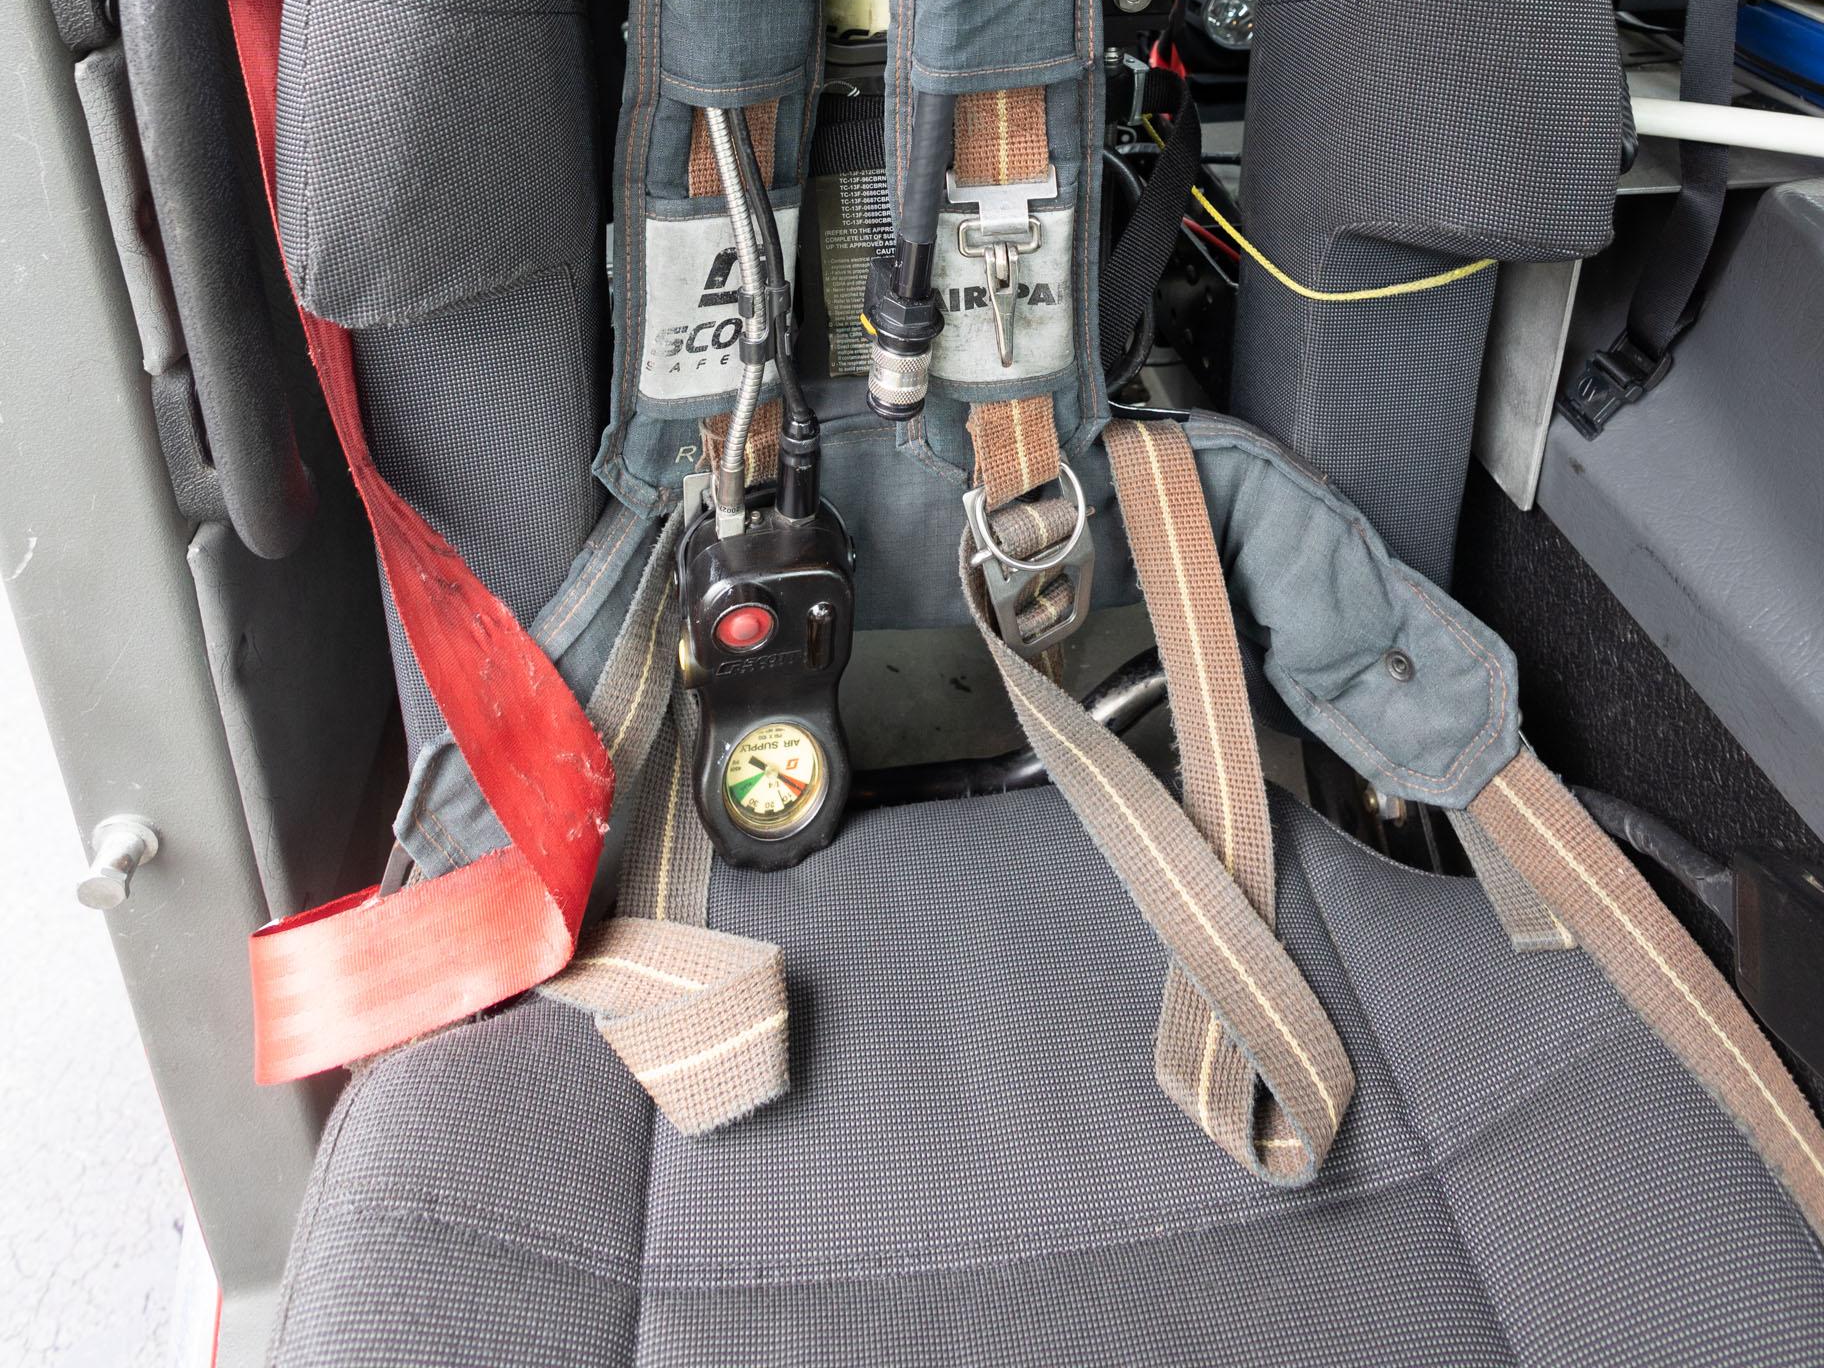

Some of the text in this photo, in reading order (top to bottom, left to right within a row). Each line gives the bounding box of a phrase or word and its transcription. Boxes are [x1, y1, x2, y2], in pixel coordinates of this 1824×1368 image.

[651, 317, 743, 357] SCO
[675, 445, 697, 463] R
[740, 738, 800, 753] AIR SUPPLY
[749, 798, 760, 808] 30
[764, 801, 775, 809] 20
